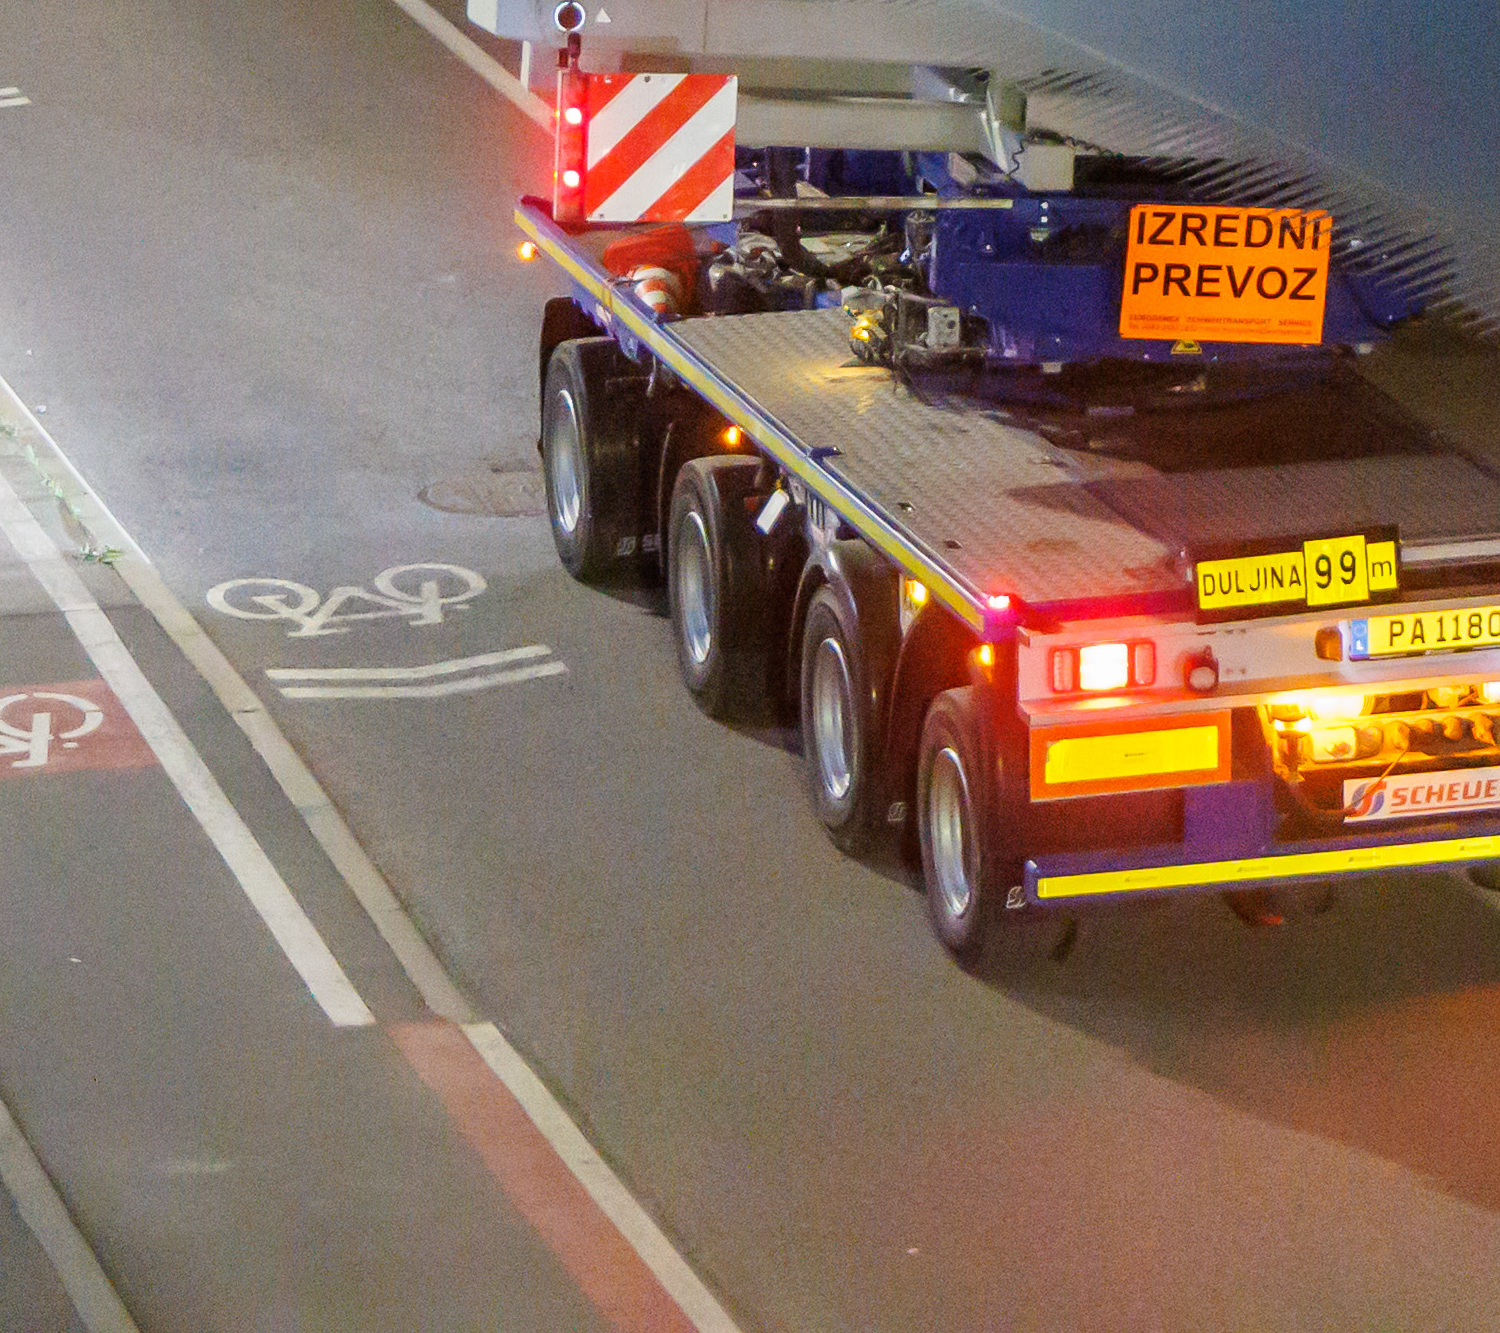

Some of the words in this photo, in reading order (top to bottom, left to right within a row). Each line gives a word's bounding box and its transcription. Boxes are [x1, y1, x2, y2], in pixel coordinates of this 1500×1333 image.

[1136, 211, 1321, 250] IZREDNI
[1132, 262, 1318, 301] PREVOZ
[1202, 564, 1301, 597] DULJINA
[1315, 550, 1358, 590] 99
[1371, 558, 1393, 579] m
[1388, 617, 1426, 647] PA
